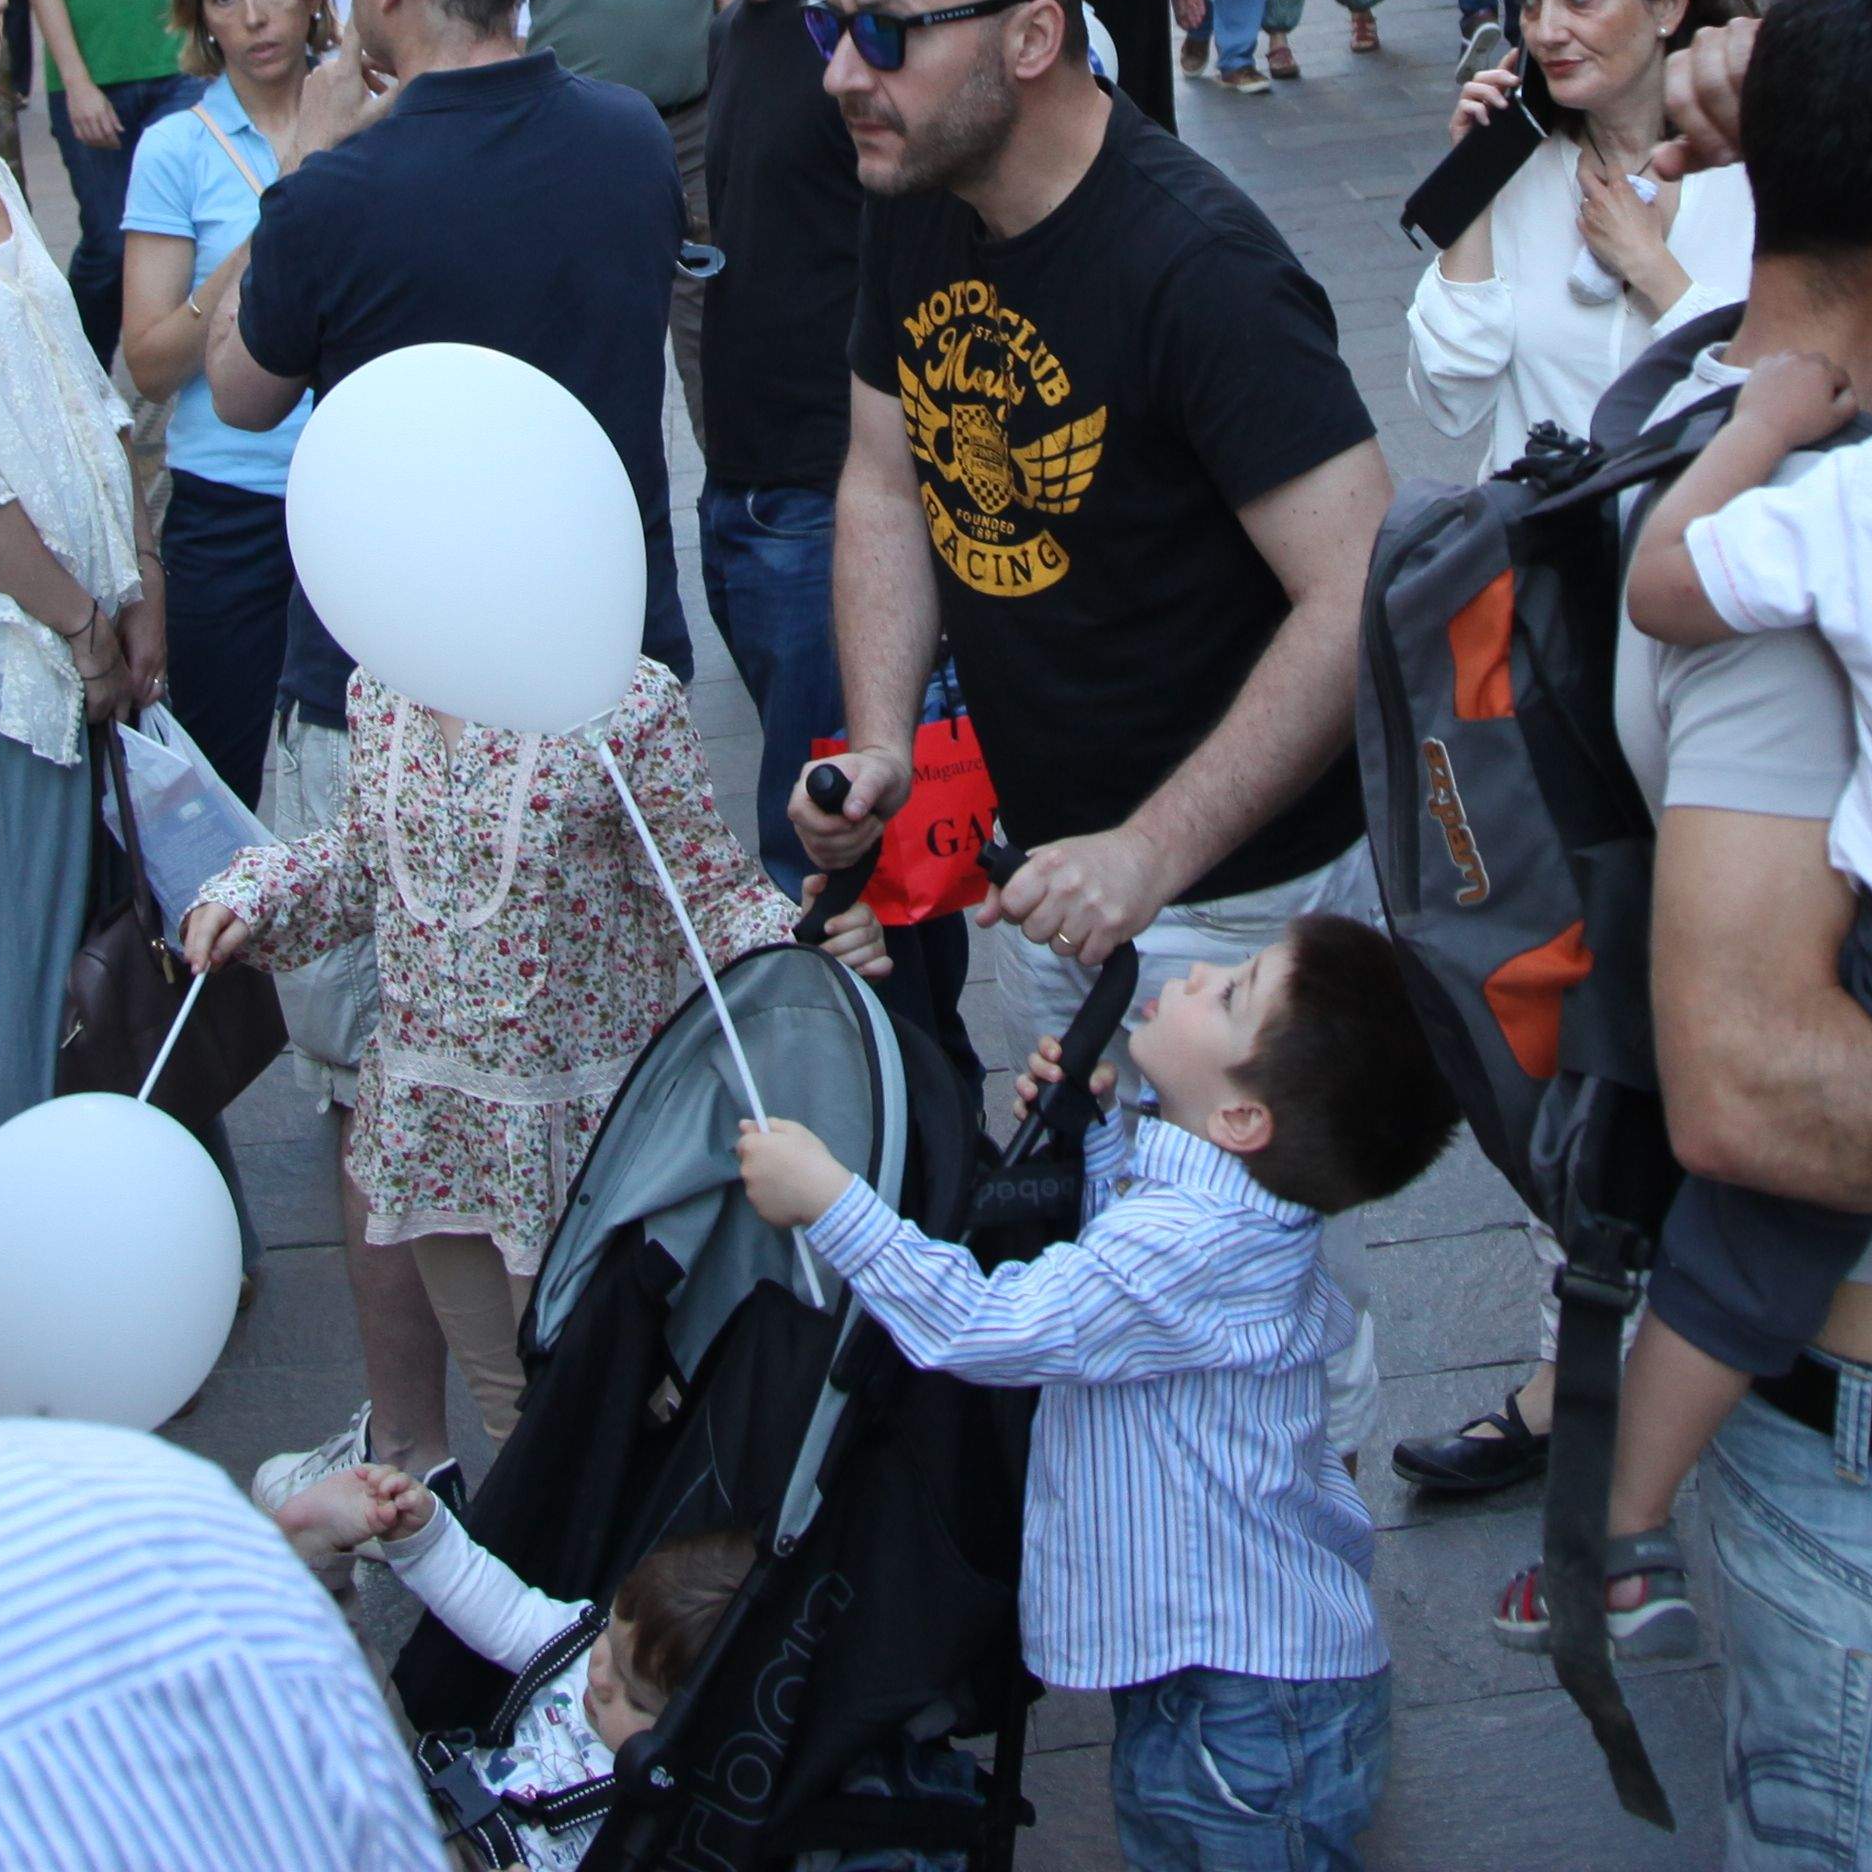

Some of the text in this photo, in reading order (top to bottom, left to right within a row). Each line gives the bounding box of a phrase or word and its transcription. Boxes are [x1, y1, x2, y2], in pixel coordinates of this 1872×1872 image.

[924, 494, 1062, 588] RACING
[956, 507, 1017, 536] FOUNDED
[913, 754, 988, 785] Magatze
[926, 806, 999, 858] GA
